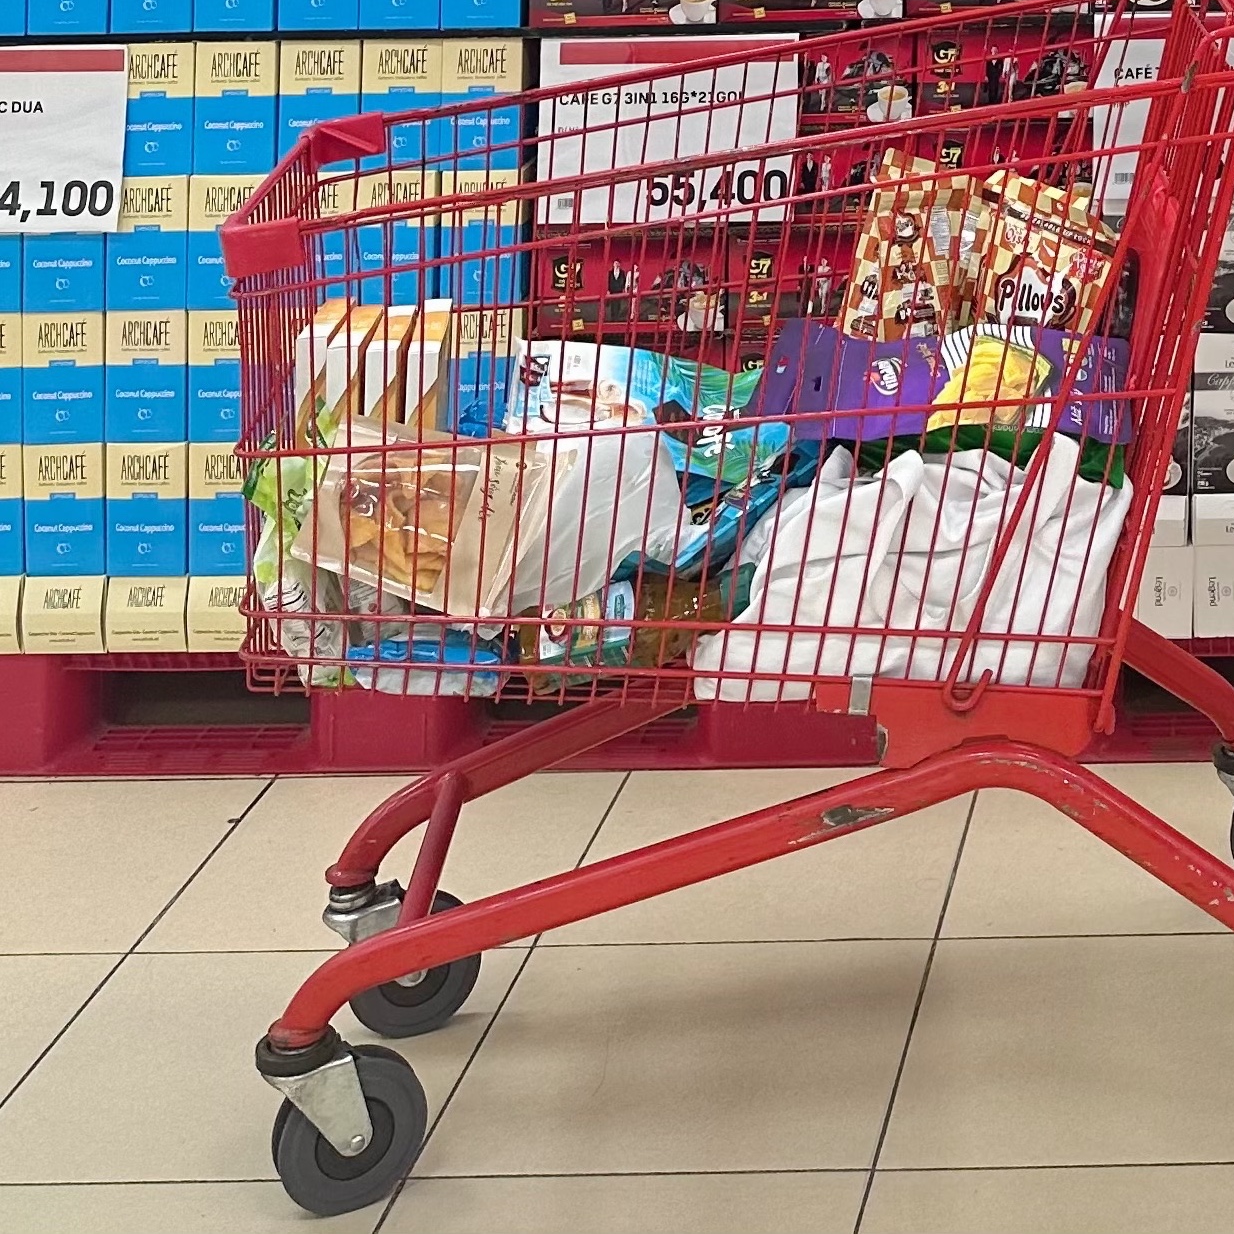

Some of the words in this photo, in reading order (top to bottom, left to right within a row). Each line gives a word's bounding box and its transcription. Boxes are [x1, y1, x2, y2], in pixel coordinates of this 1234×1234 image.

[211, 49, 262, 78] ARCHCAFÉ
[295, 47, 346, 76] ARCHCAFÉ
[12, 101, 44, 114] DUA
[37, 319, 88, 348] ARCHCAFÉ
[121, 318, 172, 347] ARCHCAFÉ
[37, 452, 88, 481] ARCHCAFÉ
